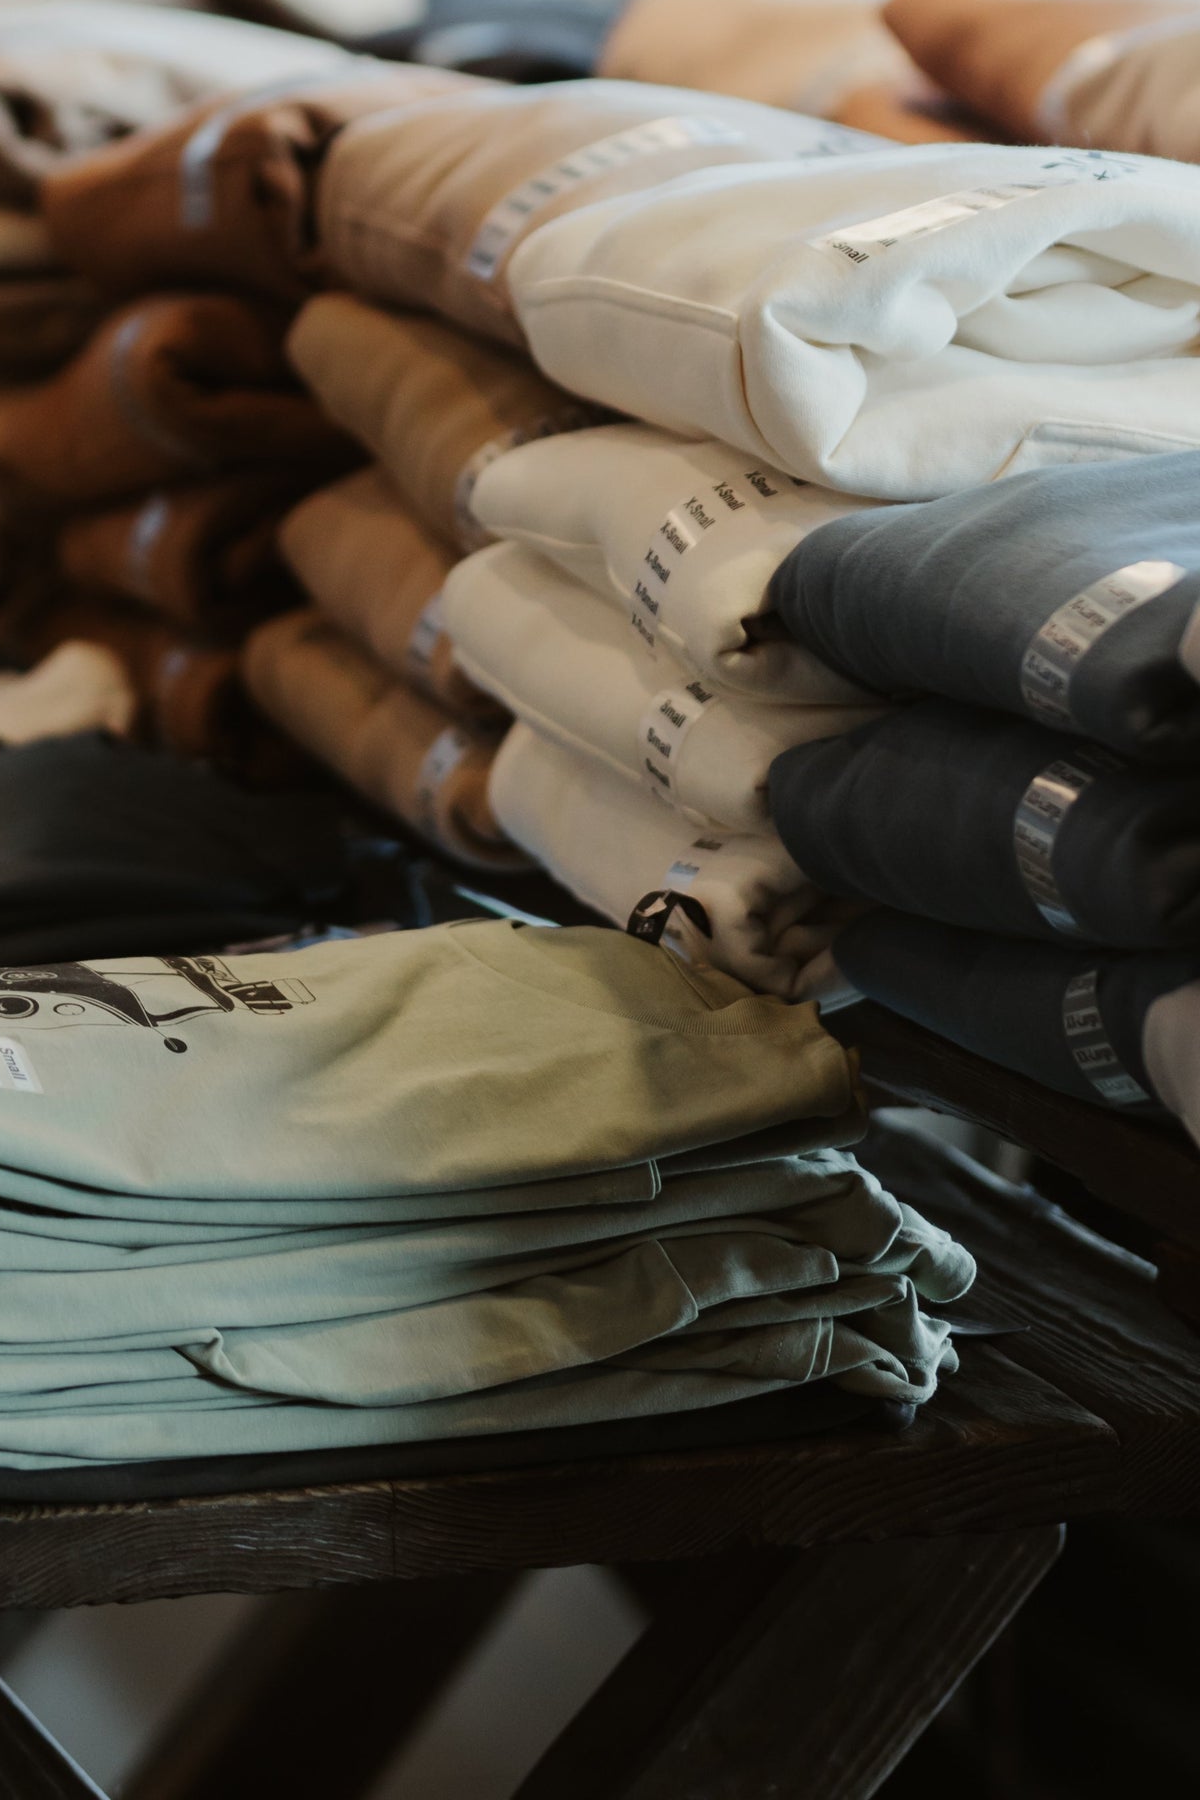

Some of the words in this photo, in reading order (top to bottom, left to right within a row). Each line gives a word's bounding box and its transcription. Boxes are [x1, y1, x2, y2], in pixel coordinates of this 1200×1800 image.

[712, 481, 745, 511] X-Small
[684, 496, 716, 530] X-Small
[659, 519, 688, 555] X-Small
[659, 698, 687, 728] Small
[646, 727, 672, 759] Small
[0, 1047, 27, 1081] Small
